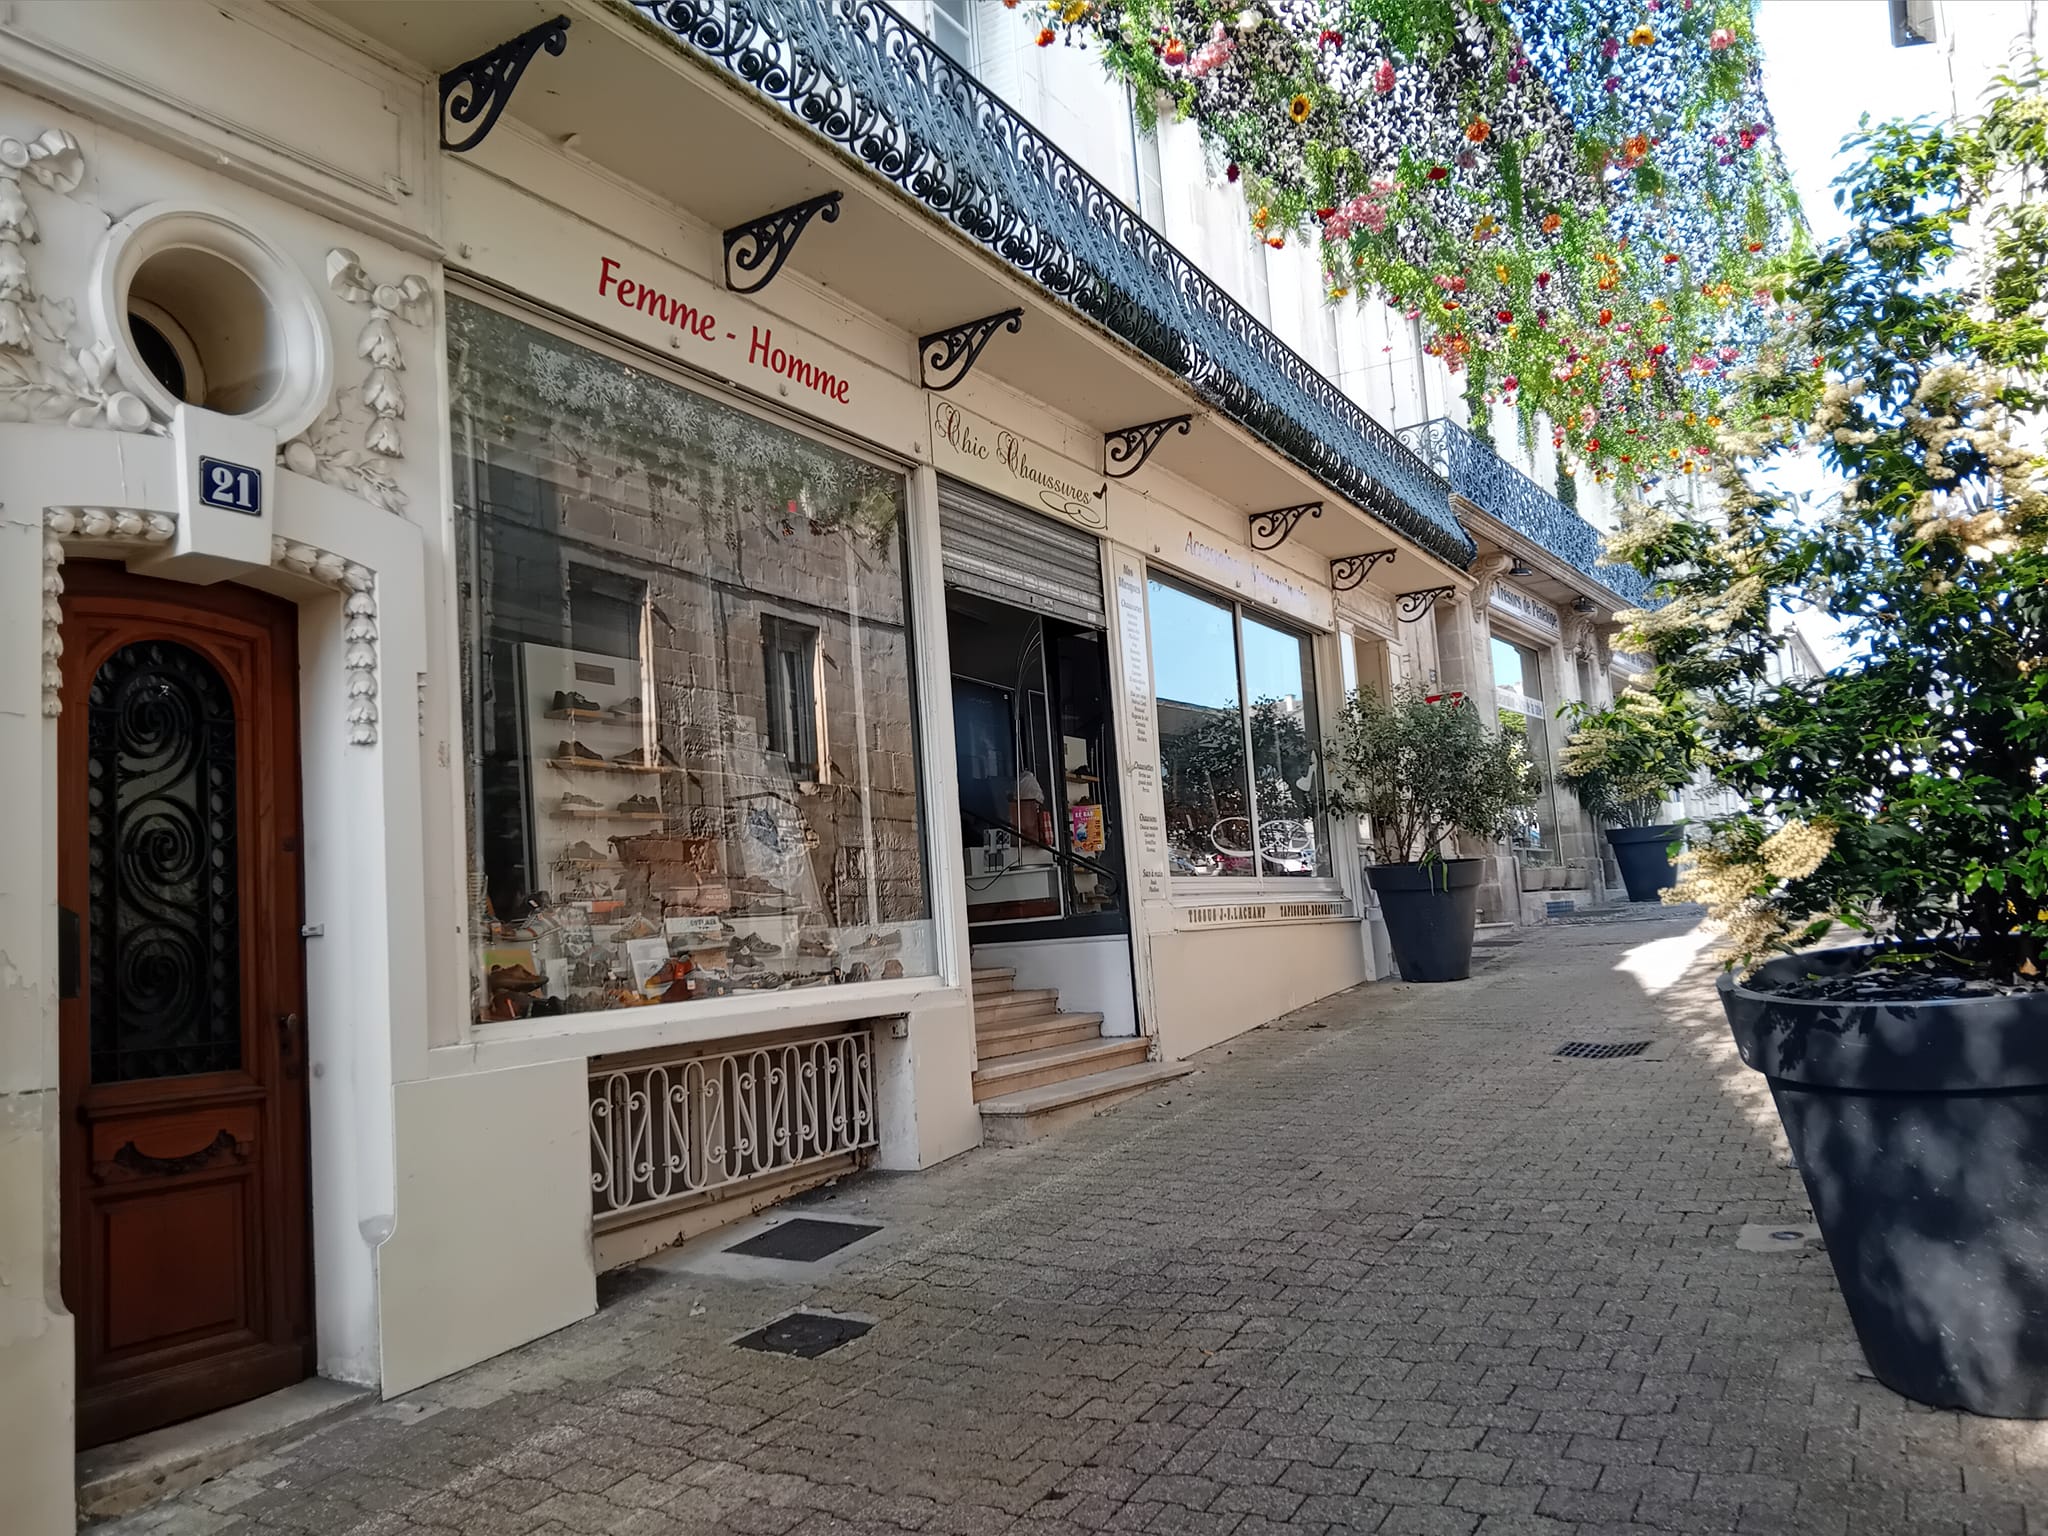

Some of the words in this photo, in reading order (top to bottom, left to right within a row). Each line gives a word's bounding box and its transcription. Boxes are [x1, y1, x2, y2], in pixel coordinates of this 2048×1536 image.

[598, 256, 716, 342] Femme
[748, 326, 850, 404] Homme
[934, 402, 989, 460] Chic
[996, 430, 1092, 505] Chaussures
[209, 466, 254, 510] 21
[1495, 580, 1522, 610] Trésors
[1523, 596, 1531, 614] de
[1188, 908, 1217, 923] TISSUS
